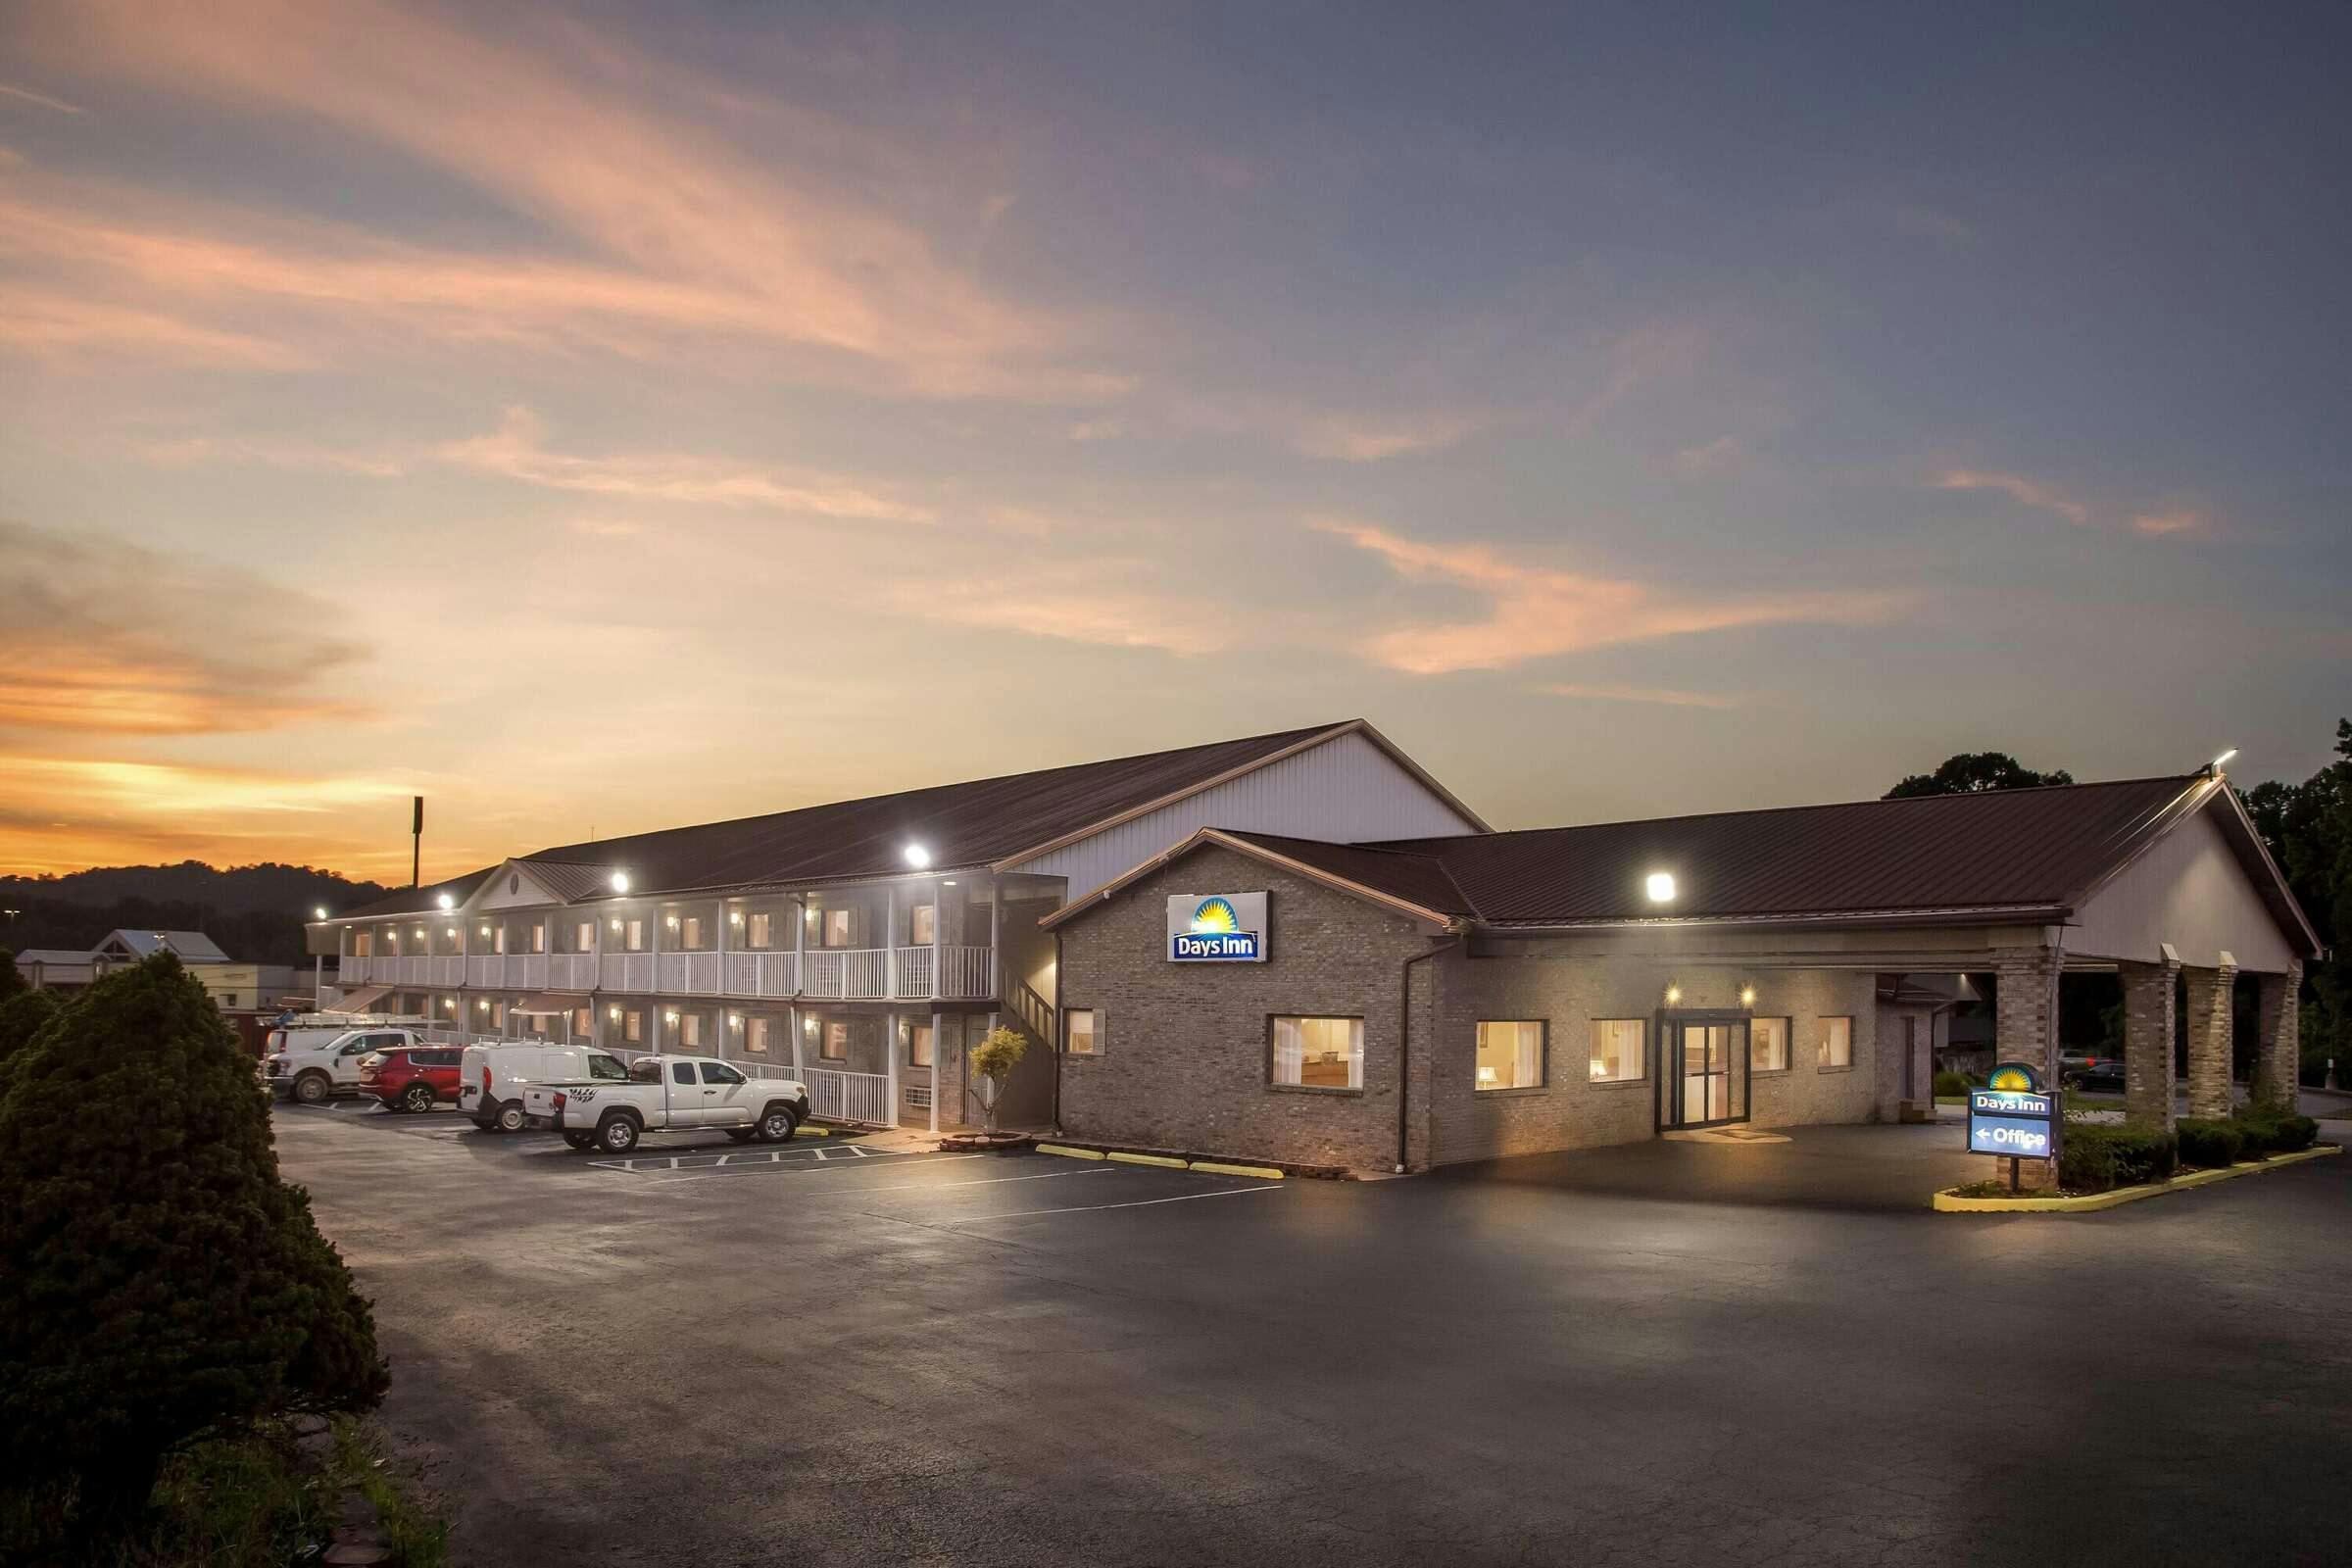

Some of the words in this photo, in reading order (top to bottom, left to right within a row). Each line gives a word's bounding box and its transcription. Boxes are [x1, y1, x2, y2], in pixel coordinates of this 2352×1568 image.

[1178, 938, 1221, 956] Days
[1222, 937, 1253, 955] Inn
[1977, 1097, 2016, 1110] Days
[2018, 1097, 2045, 1111] Inn
[1993, 1128, 2047, 1148] Office
